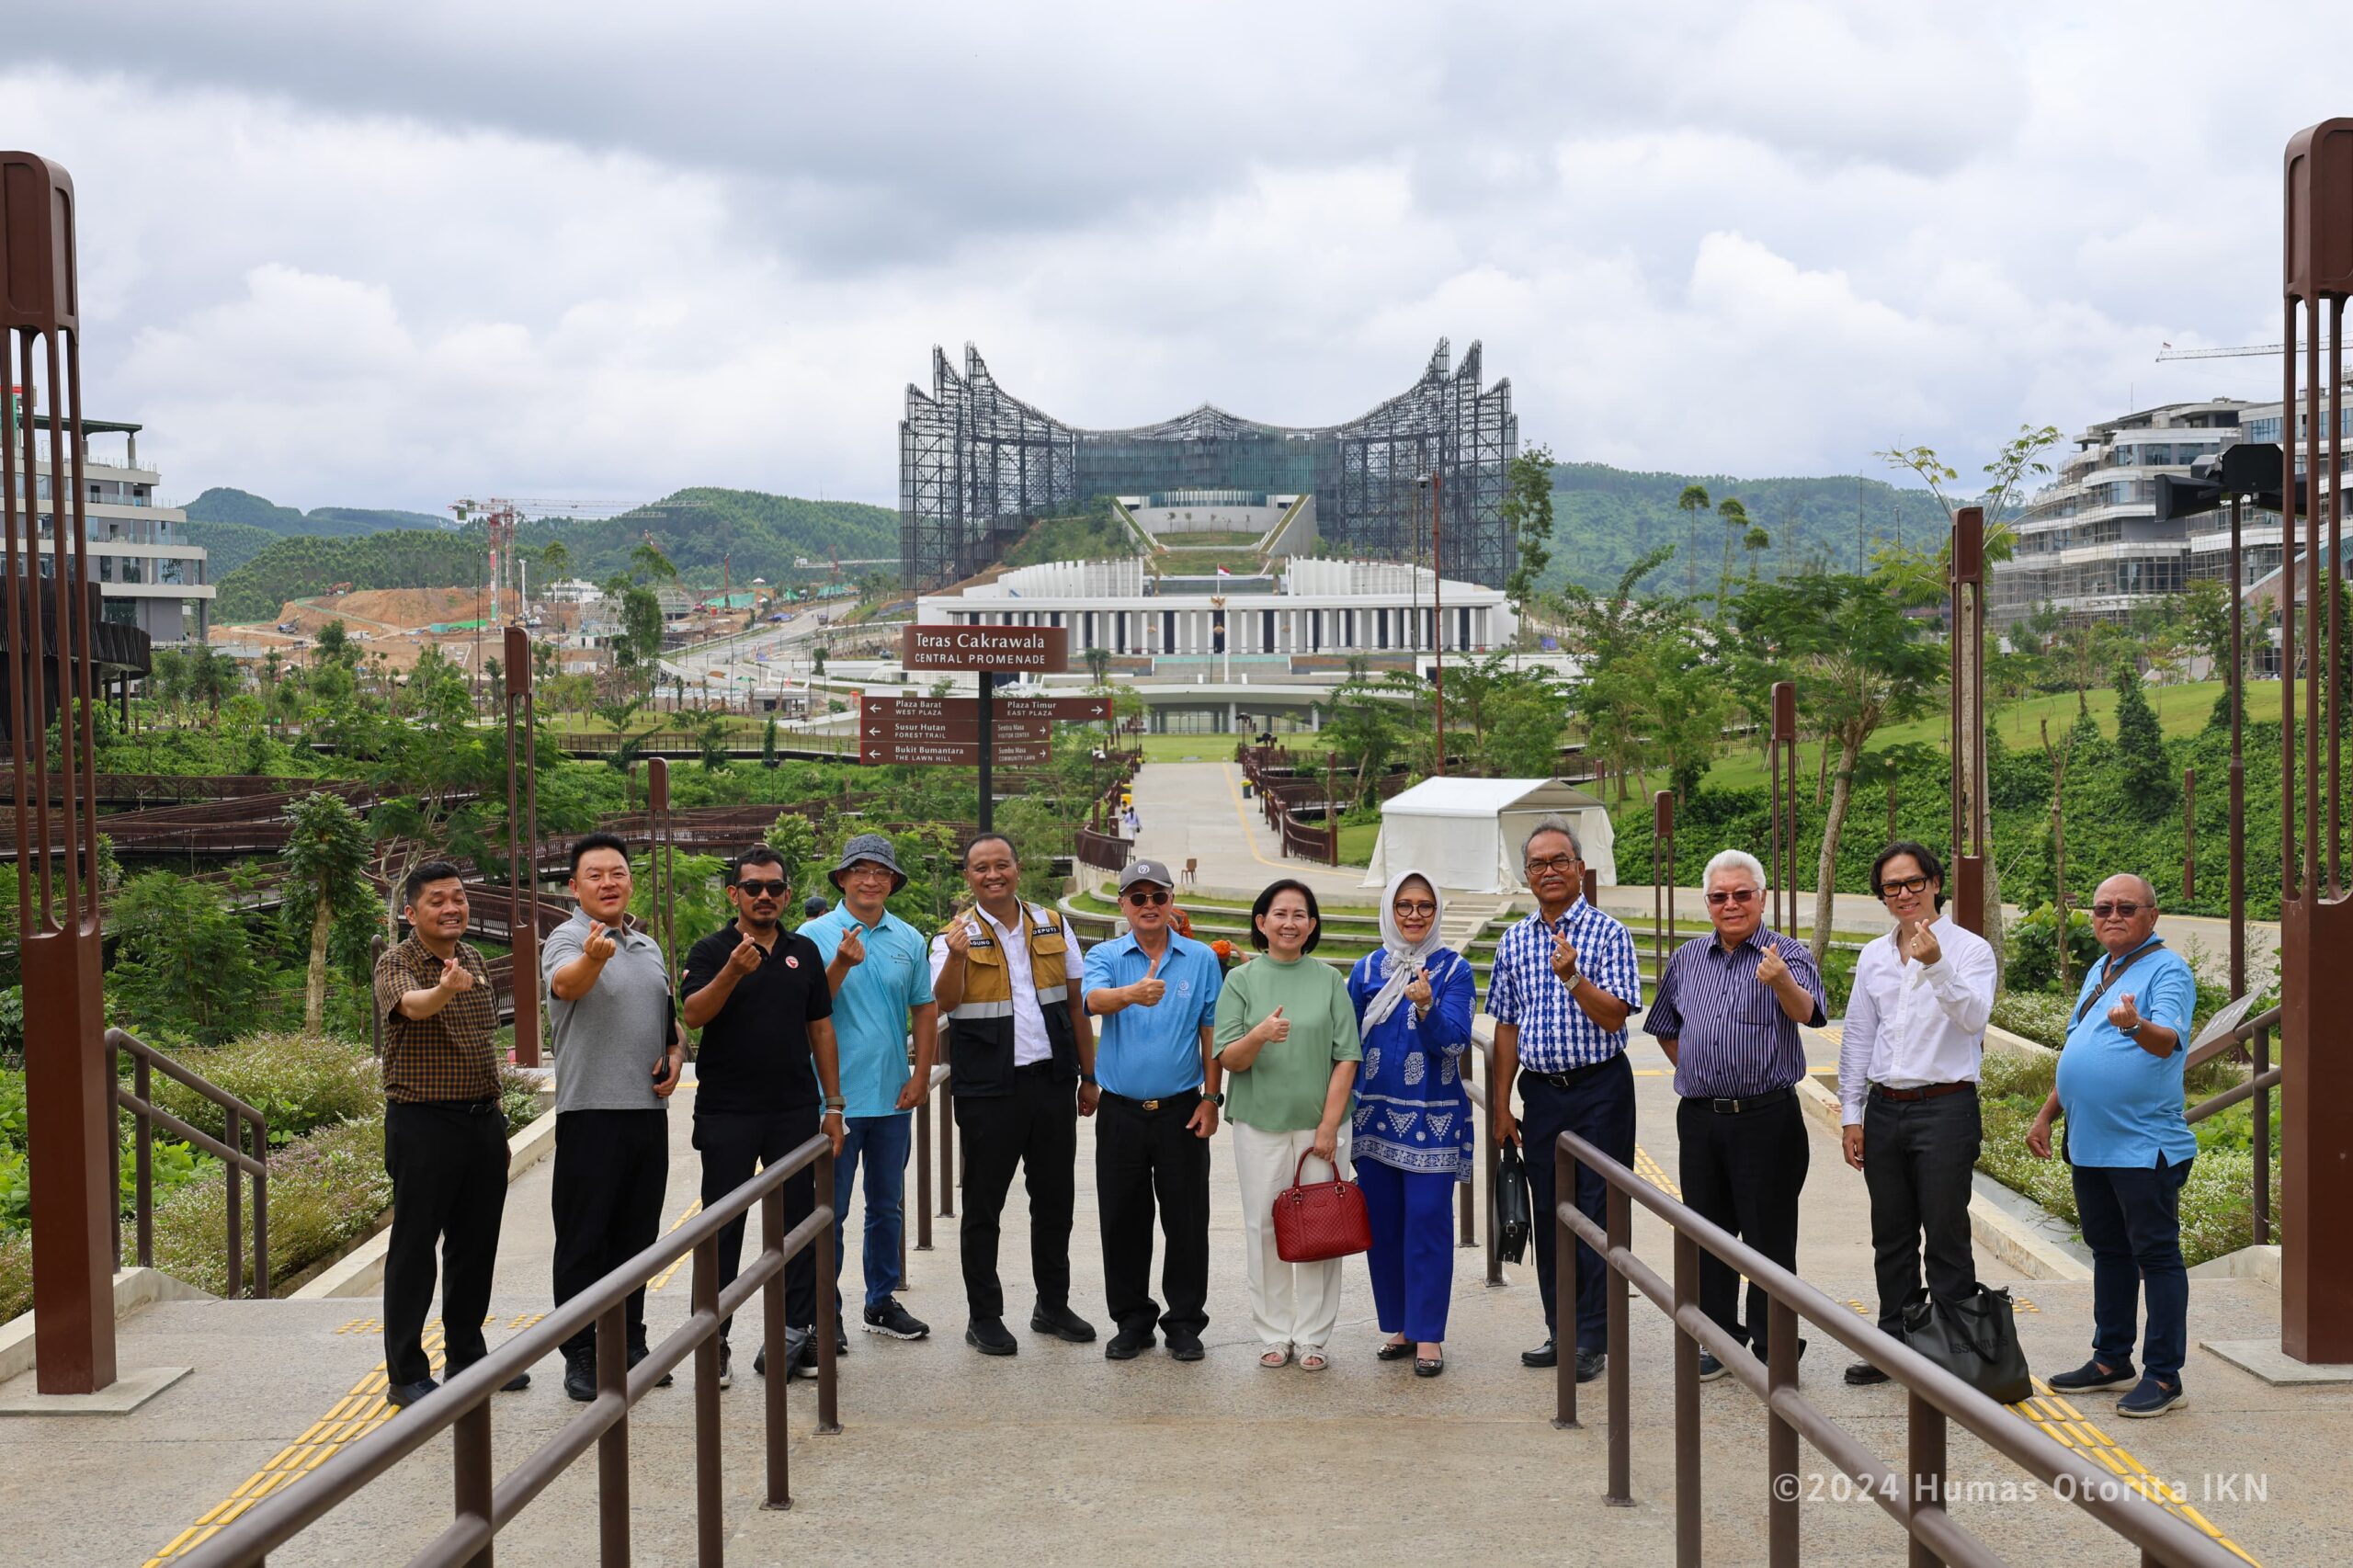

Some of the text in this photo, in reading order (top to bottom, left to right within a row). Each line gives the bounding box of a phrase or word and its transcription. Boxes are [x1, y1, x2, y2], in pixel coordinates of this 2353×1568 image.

[915, 632, 1045, 649] Teras Cakrawala
[915, 653, 1045, 665] CENTRAL PROMENADE
[895, 699, 942, 709] Plaza Barat
[1007, 700, 1029, 709] Plaza
[895, 745, 964, 755] Bukit Bumantara
